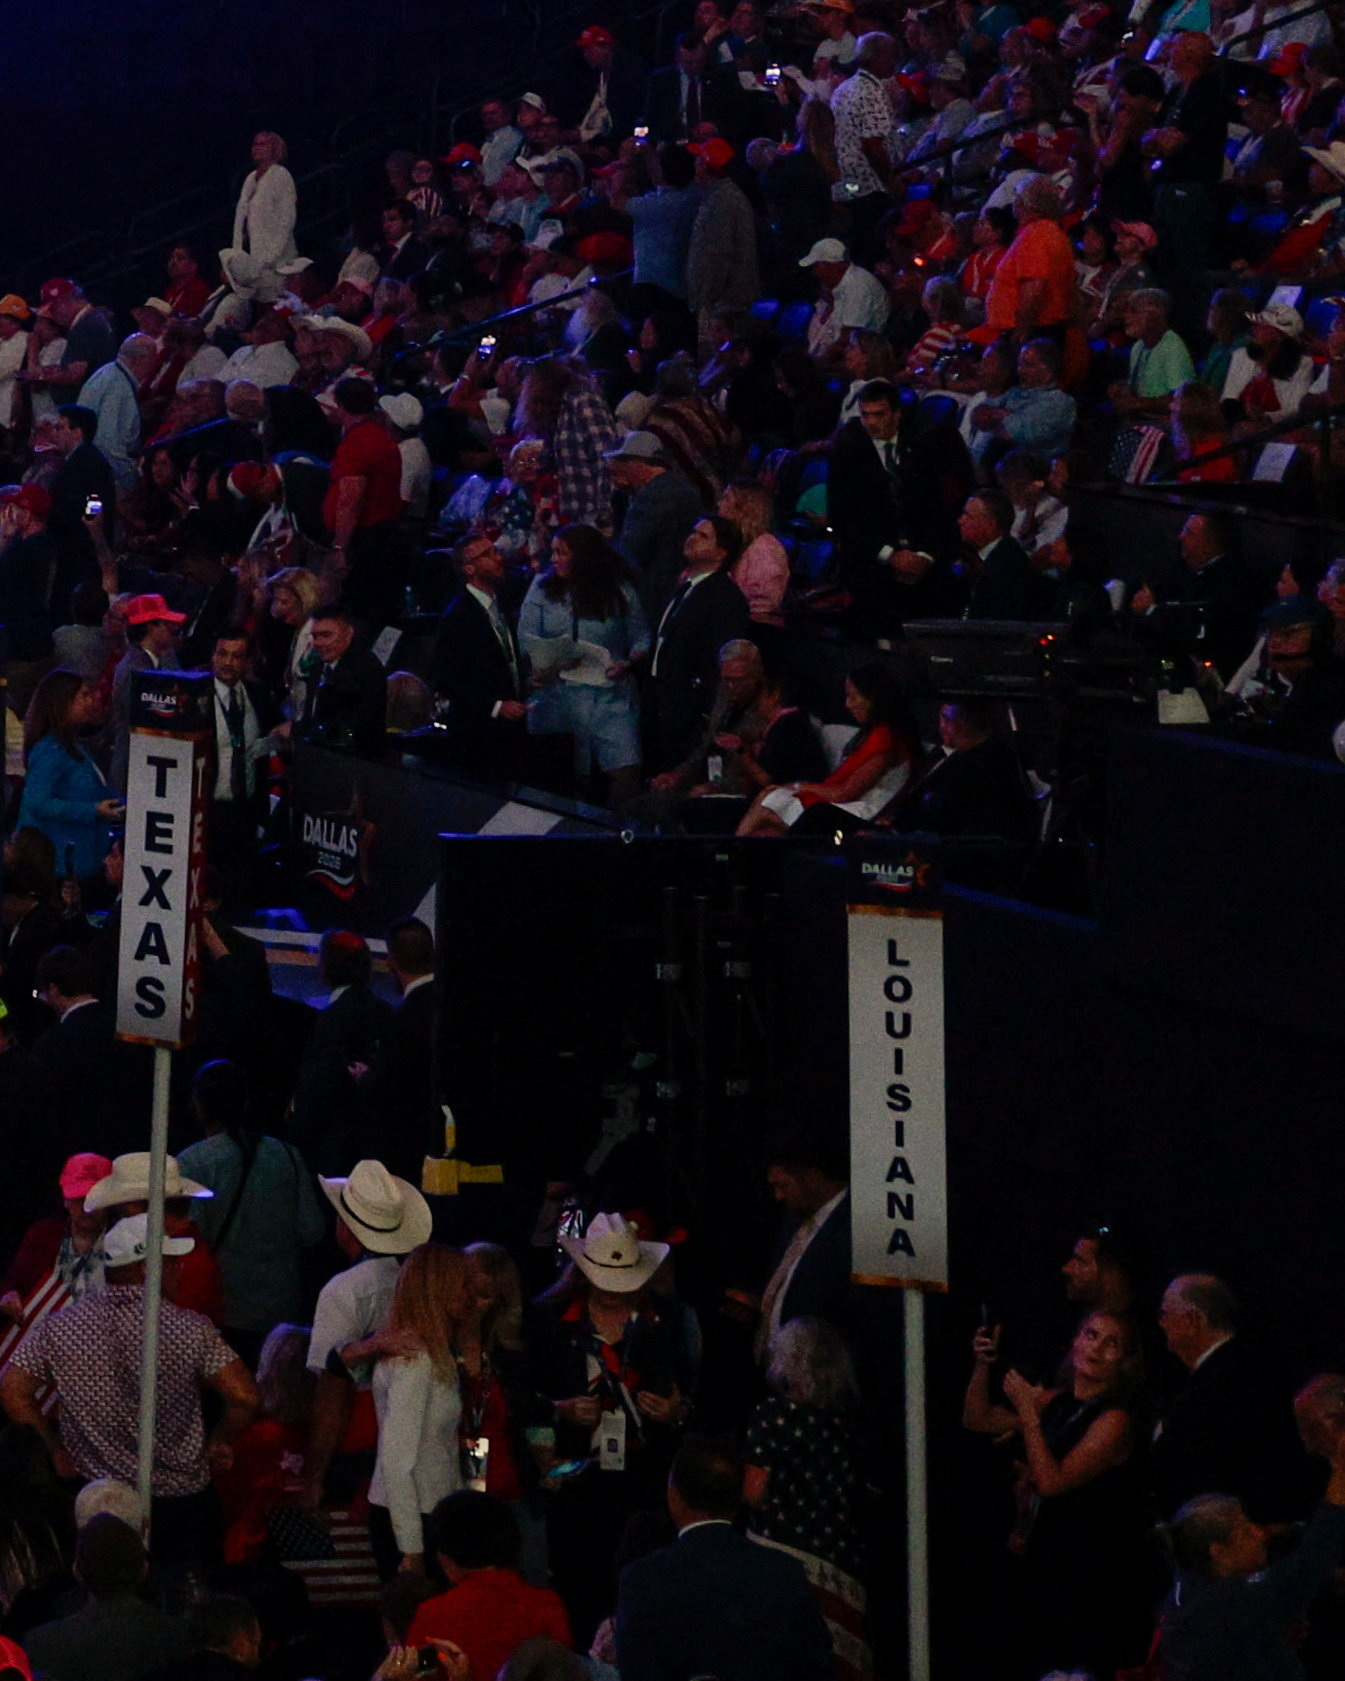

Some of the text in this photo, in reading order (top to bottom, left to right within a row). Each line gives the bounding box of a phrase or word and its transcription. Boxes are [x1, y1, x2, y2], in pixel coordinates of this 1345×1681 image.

[134, 755, 177, 1019] TEXAS
[184, 756, 206, 1021] TEXAS
[302, 811, 358, 858] DALLAS
[861, 861, 914, 877] DALLAS
[883, 937, 916, 1257] LOUISIANA
